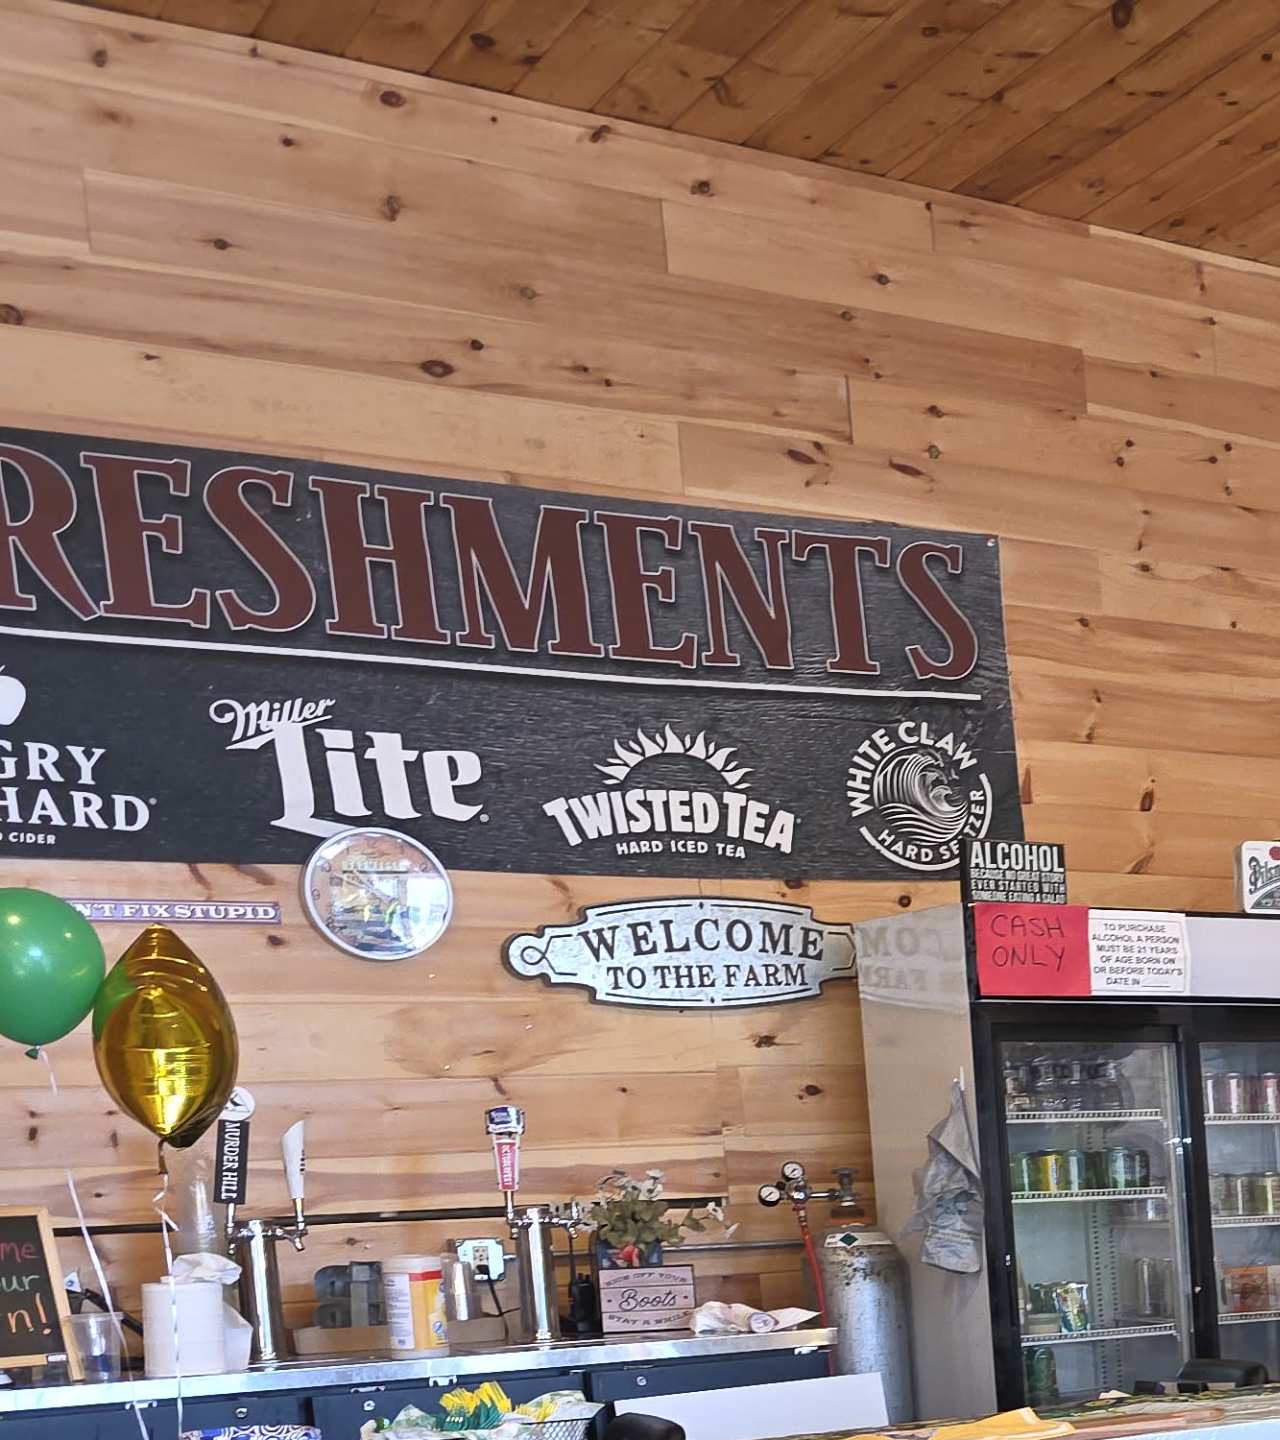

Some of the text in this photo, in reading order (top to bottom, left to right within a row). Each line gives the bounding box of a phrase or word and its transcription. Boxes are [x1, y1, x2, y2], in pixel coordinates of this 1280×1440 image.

[208, 697, 336, 747] Miller
[270, 721, 485, 838] Lite
[846, 720, 978, 817] WHITE CLAW
[541, 788, 796, 855] TWISTED TEA
[877, 789, 985, 862] HARD SETZER
[8, 832, 57, 845] CIDER
[615, 840, 747, 859] HARD ICED TEA
[969, 841, 1065, 873] ALCOHOL
[970, 879, 1066, 894] EVER STARTED WITH
[122, 903, 175, 918] FIX
[175, 904, 276, 920] STUPID
[990, 913, 1065, 938] CASH
[1103, 923, 1167, 933] TO PURCHASE
[577, 918, 826, 963] WELCOME
[1092, 933, 1135, 943] ALCOHOL
[1145, 935, 1180, 944] PERSON
[1096, 944, 1121, 953] MUST
[1122, 945, 1135, 953] BE
[1150, 946, 1179, 955] YEARS
[991, 943, 1066, 973] ONLY
[1100, 955, 1113, 964] OF
[1114, 955, 1134, 964] AGE
[606, 963, 809, 990] TO THE FARM
[1105, 977, 1130, 986] DATE
[1109, 966, 1145, 976] BEFORE
[220, 1121, 241, 1200] MURDER HILL
[0, 1274, 40, 1293] ur
[618, 1288, 678, 1312] Boots
